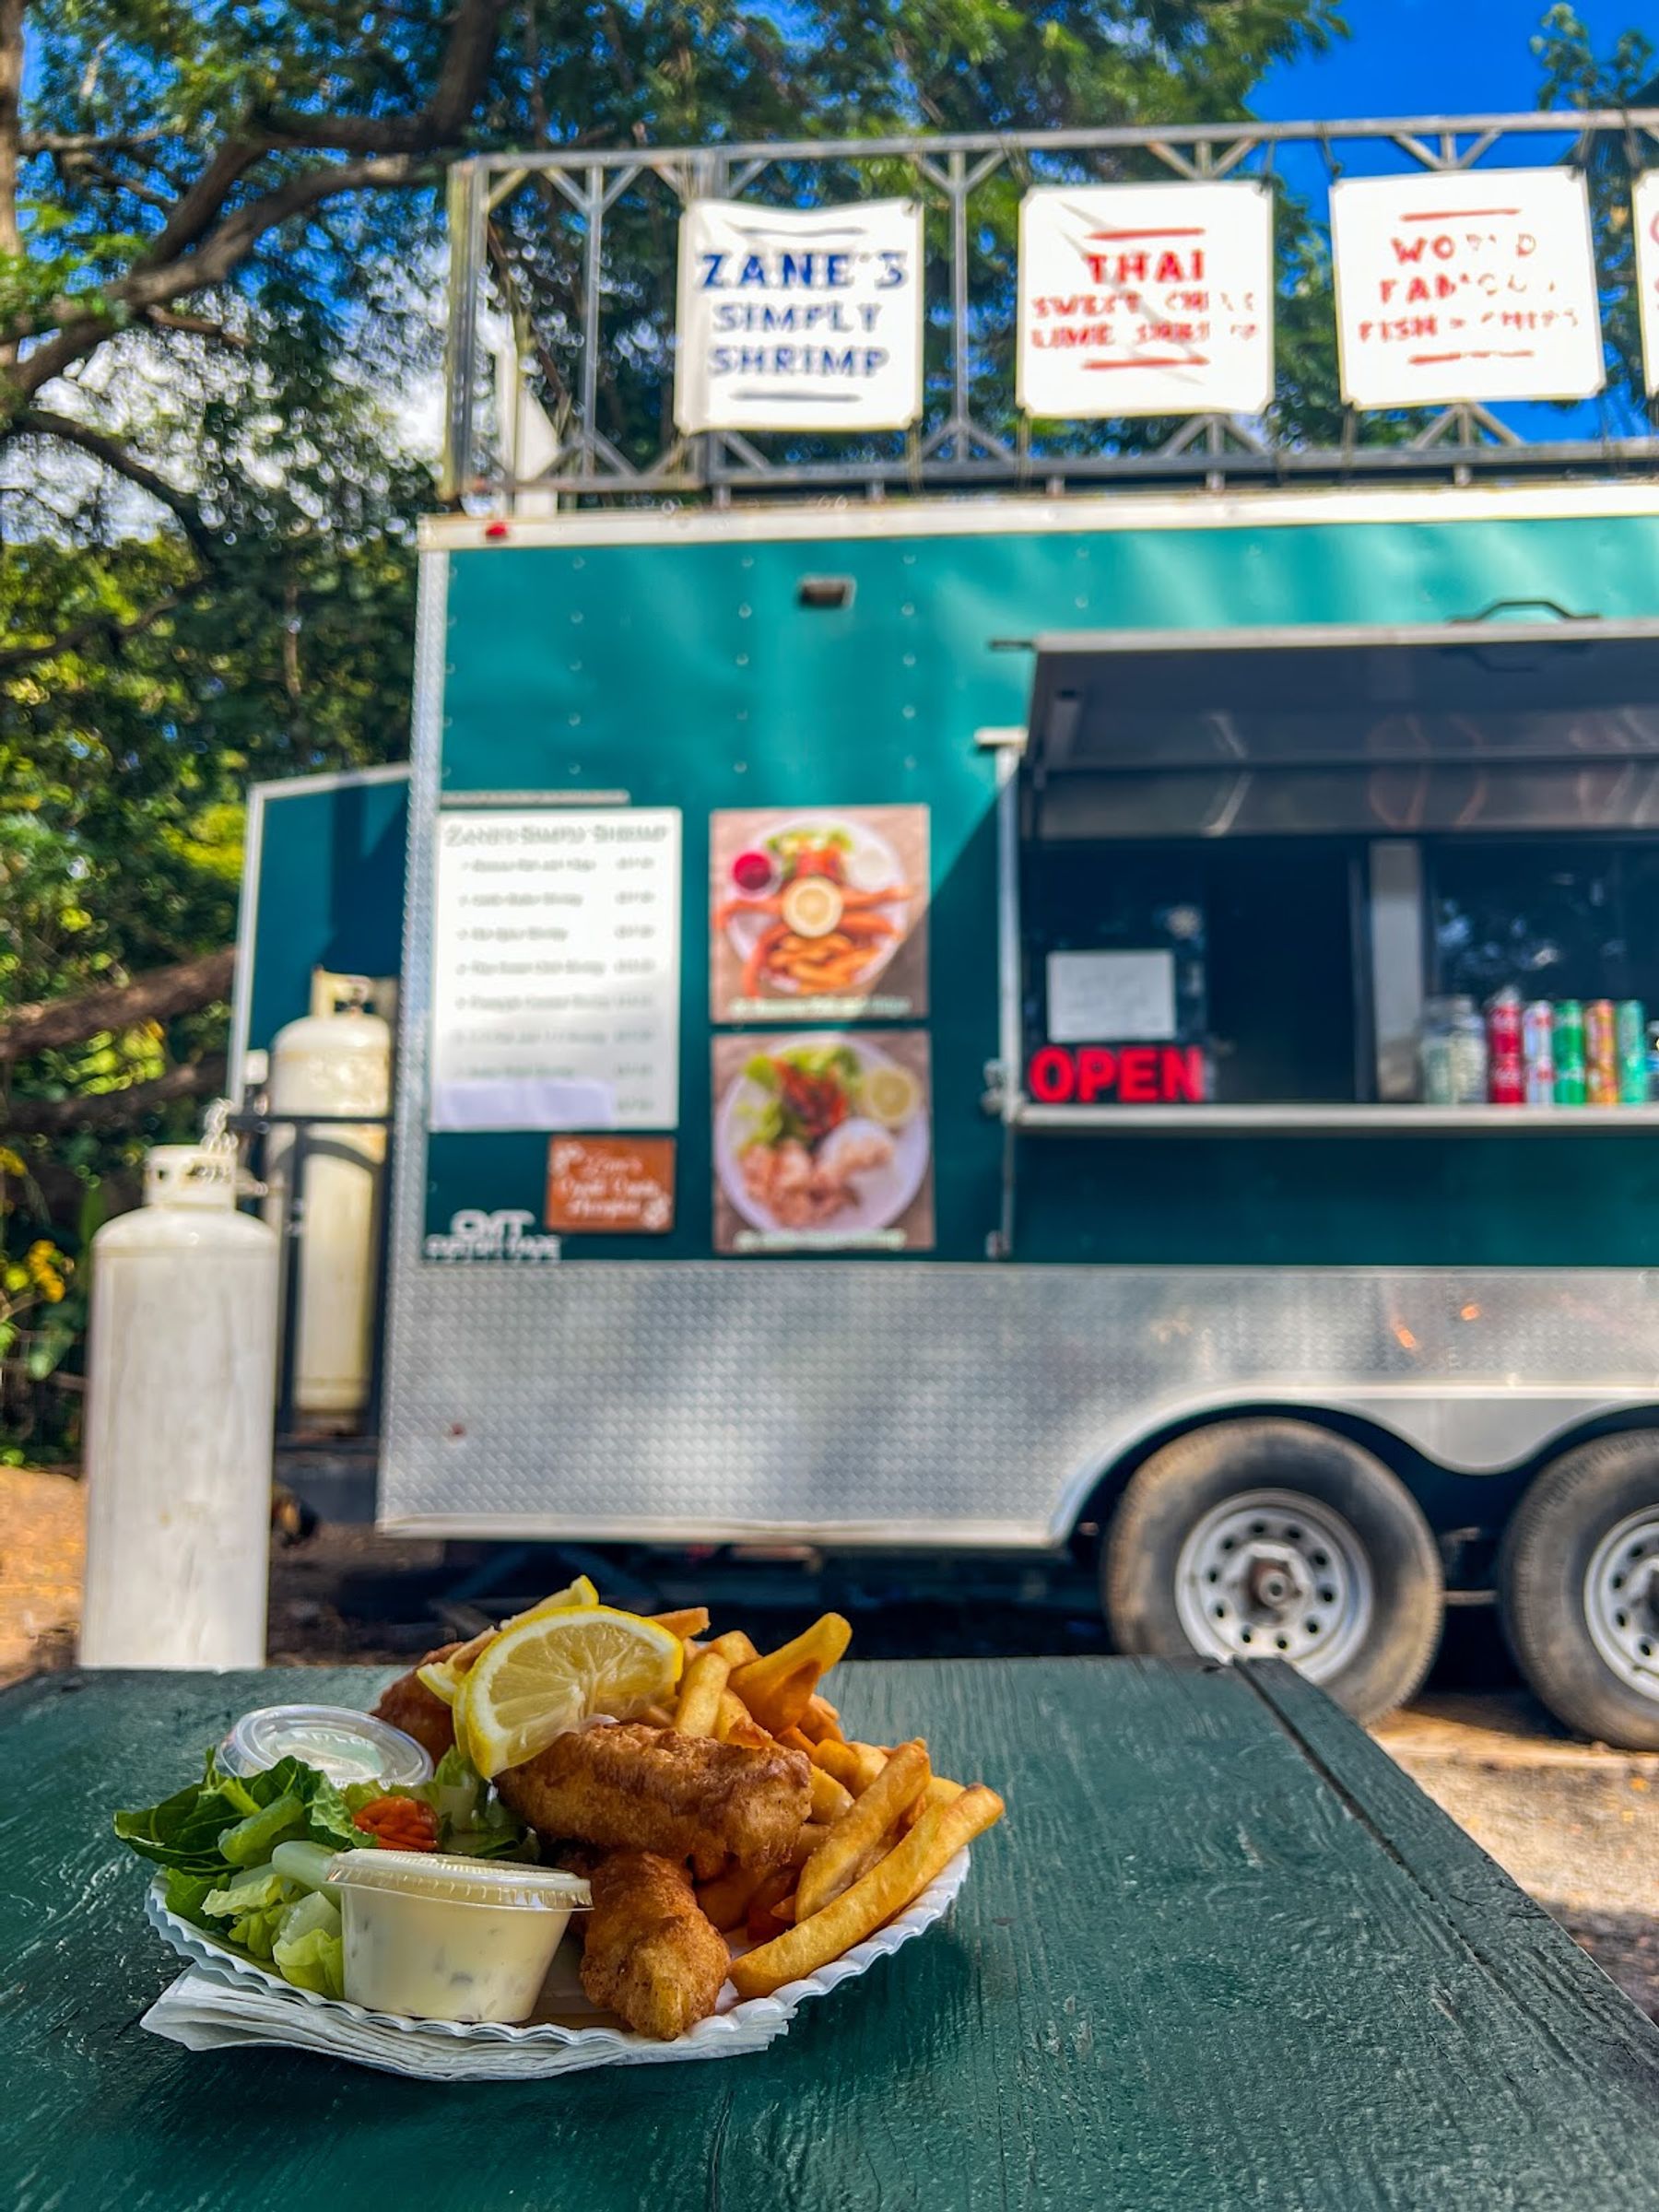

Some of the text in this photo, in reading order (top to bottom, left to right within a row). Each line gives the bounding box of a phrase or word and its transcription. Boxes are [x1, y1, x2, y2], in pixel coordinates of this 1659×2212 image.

[1390, 232, 1536, 265] WOD
[1084, 248, 1206, 285] THAI
[712, 300, 882, 333] SIMPLY
[1359, 315, 1439, 344] FISH
[1031, 324, 1116, 349] LIME
[707, 344, 890, 377] SHRIMP
[1028, 1045, 1205, 1103] OPEN
